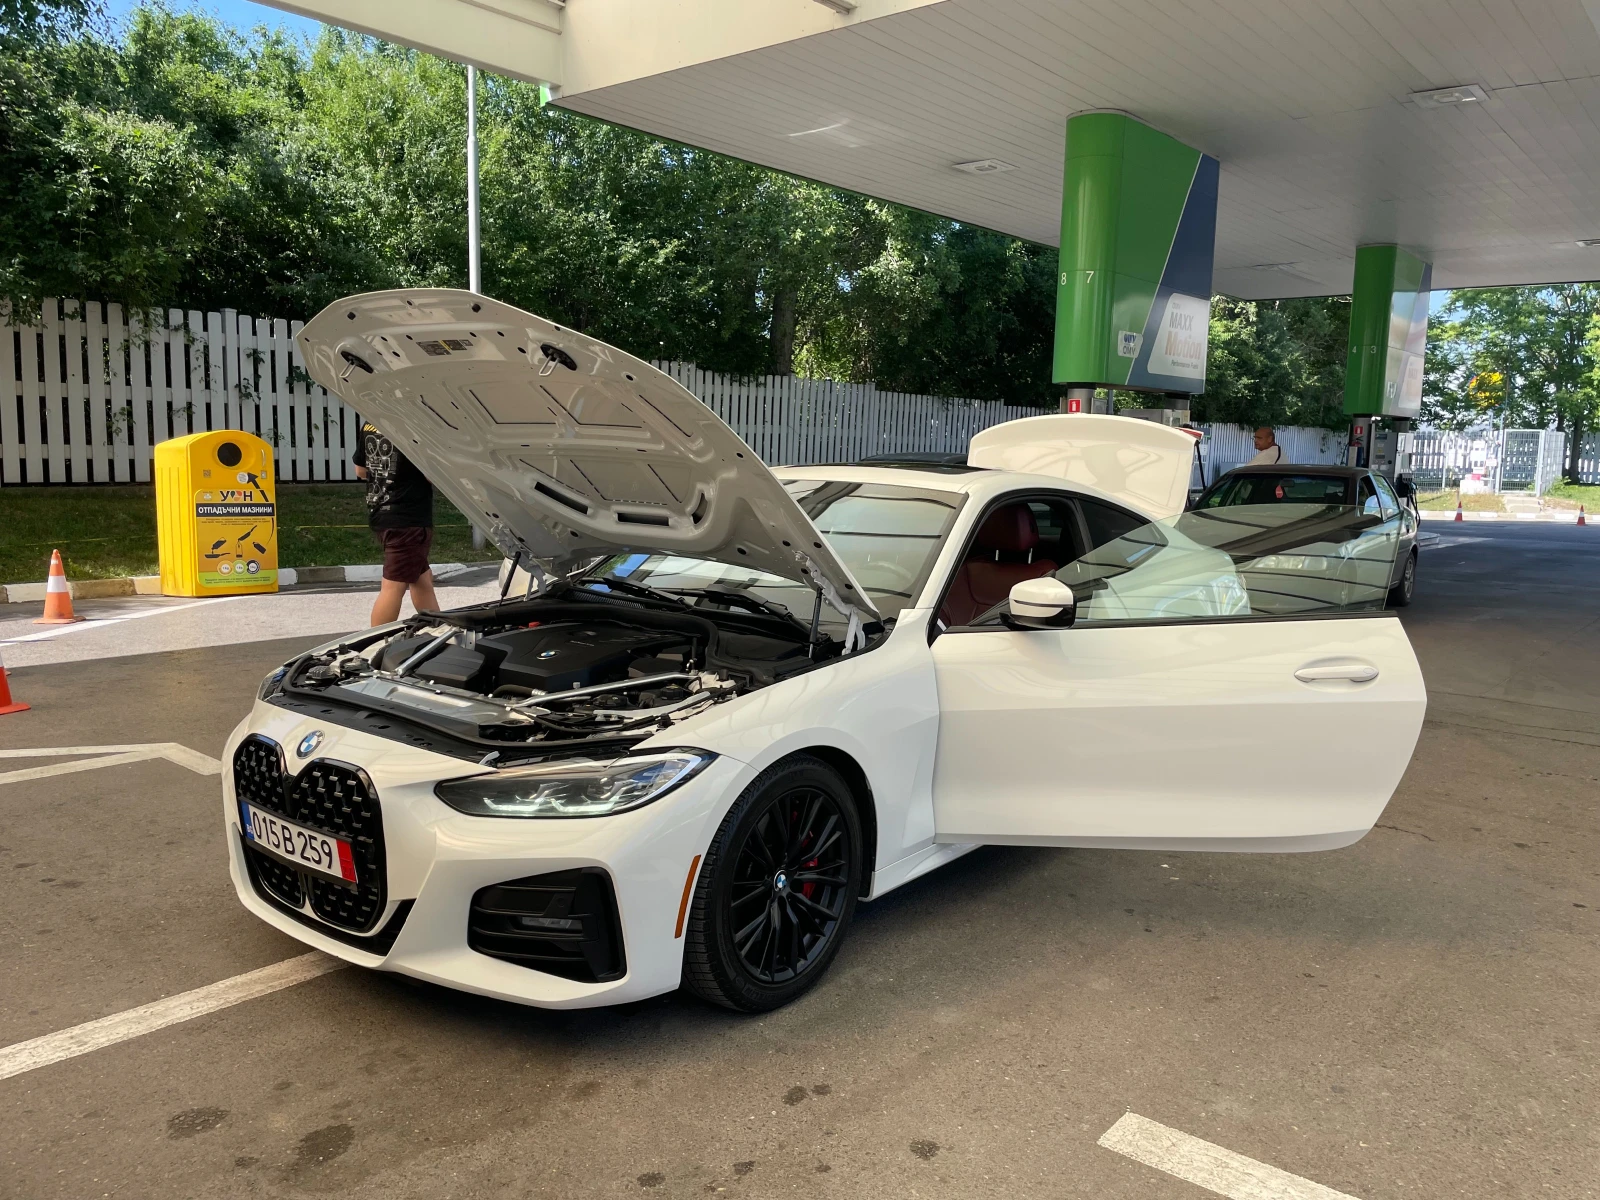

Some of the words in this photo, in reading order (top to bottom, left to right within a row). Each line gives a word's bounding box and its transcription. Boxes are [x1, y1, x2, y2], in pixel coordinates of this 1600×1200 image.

[1060, 272, 1067, 285] 8
[1086, 271, 1094, 283] 7
[1170, 312, 1194, 331] MAXX
[198, 506, 240, 514] ОТПАДЪЧНИ
